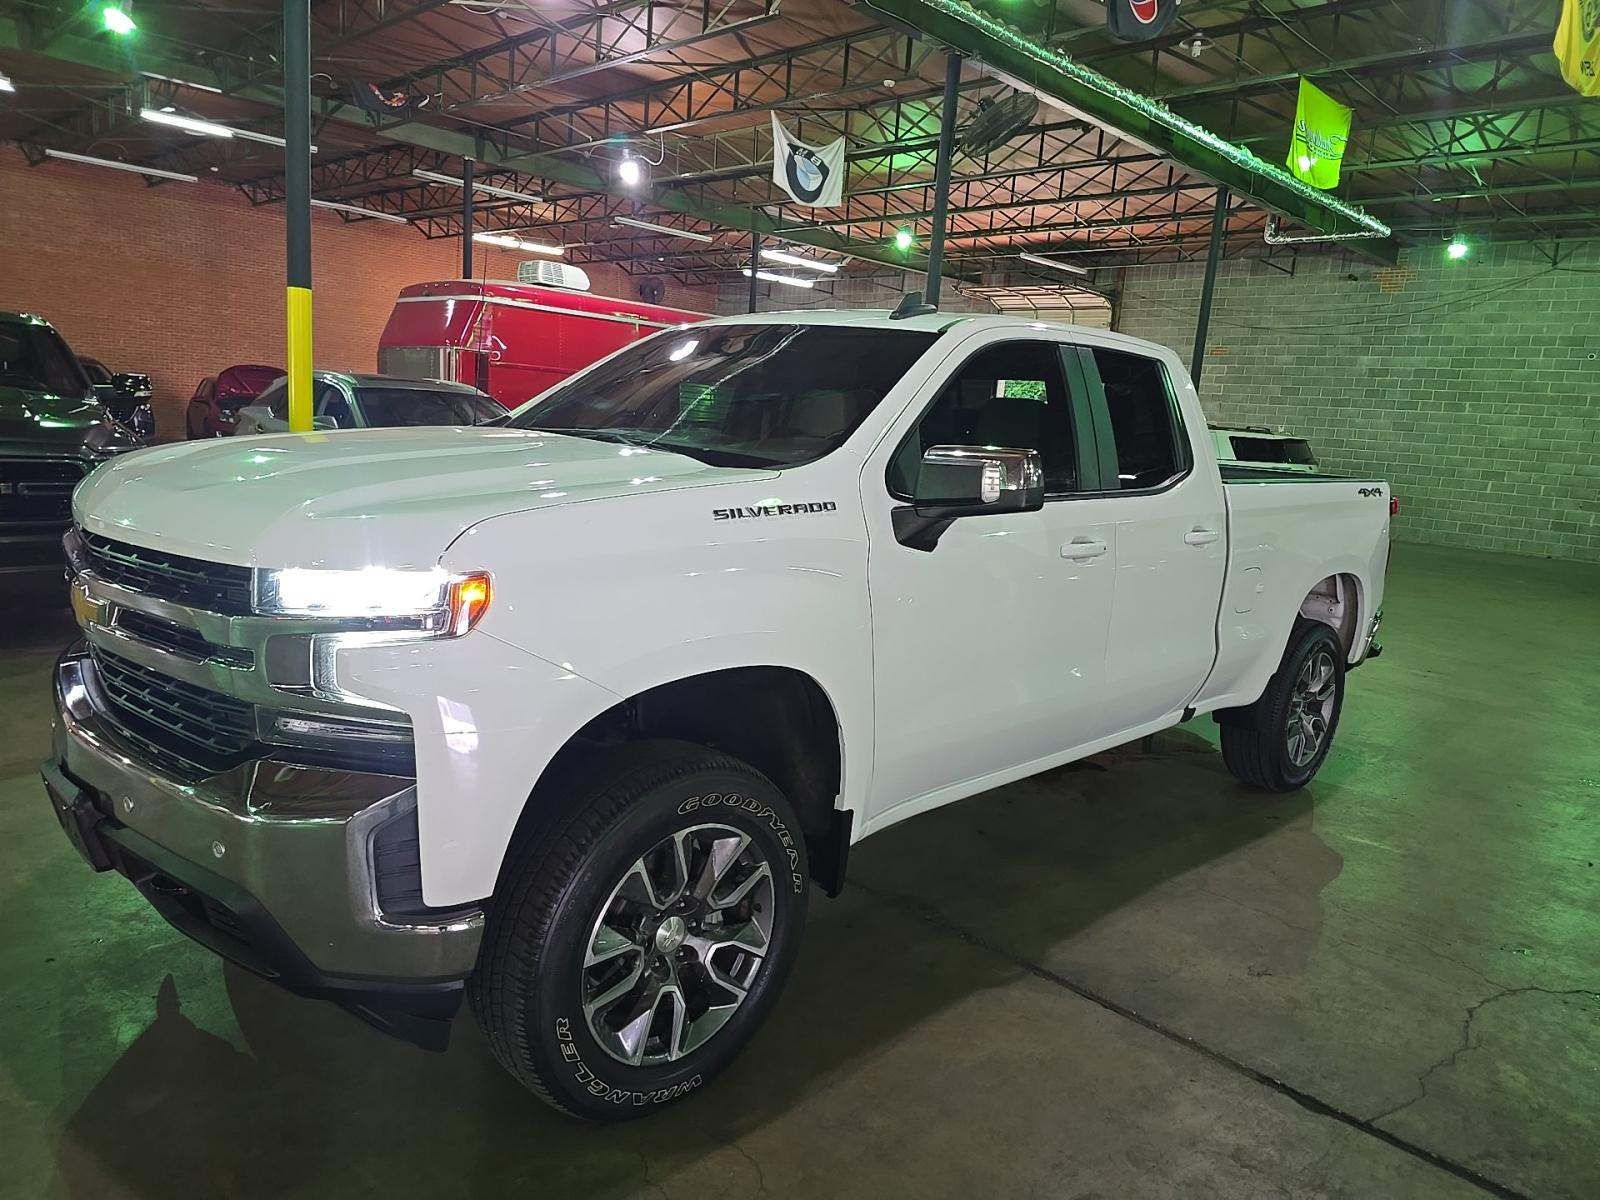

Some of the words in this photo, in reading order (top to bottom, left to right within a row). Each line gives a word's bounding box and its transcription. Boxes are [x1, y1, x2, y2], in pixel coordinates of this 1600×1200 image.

[712, 501, 837, 521] SILVERADO
[677, 793, 803, 894] GOODYEAR
[556, 1016, 702, 1106] WRANGLER
